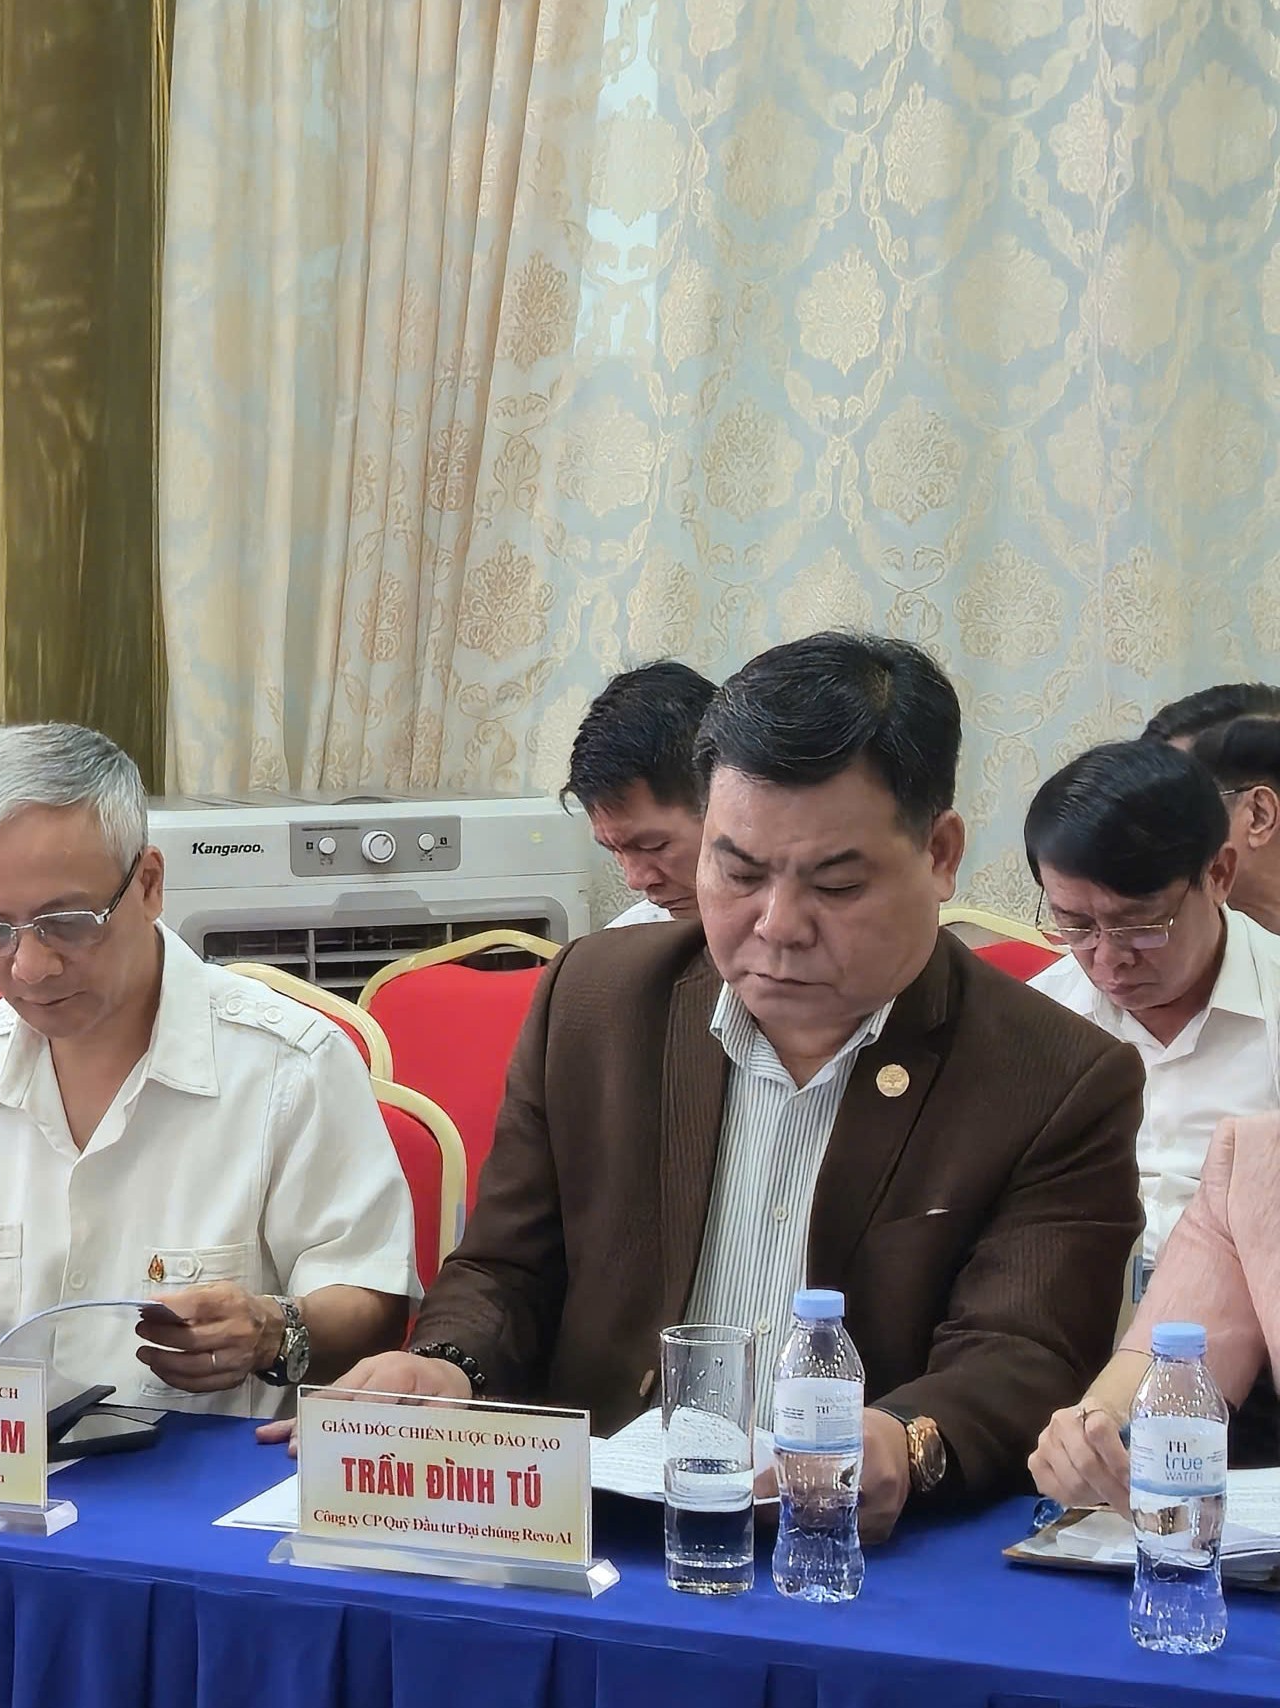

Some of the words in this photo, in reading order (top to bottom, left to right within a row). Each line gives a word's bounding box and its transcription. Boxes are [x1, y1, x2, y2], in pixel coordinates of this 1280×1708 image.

[192, 842, 261, 856] Kangaroo
[321, 1418, 361, 1435] GIÁM
[364, 1420, 396, 1437] ĐỐC
[398, 1424, 444, 1442] CHIẾN
[448, 1429, 491, 1446] LƯỢC
[494, 1431, 526, 1448] ĐÀO
[528, 1436, 561, 1452] TẠO
[1165, 1453, 1203, 1470] true
[341, 1452, 414, 1497] TRẦN
[426, 1458, 495, 1504] ĐÌNH
[507, 1464, 542, 1508] TÚ
[313, 1509, 346, 1527] Công
[348, 1515, 359, 1528] ty
[362, 1513, 383, 1527] CP
[384, 1516, 410, 1532] Quỹ
[413, 1516, 439, 1533] Đầu
[441, 1522, 456, 1534] tư
[457, 1521, 479, 1539] Đại
[481, 1524, 520, 1542] chúng
[521, 1528, 554, 1543] Revo
